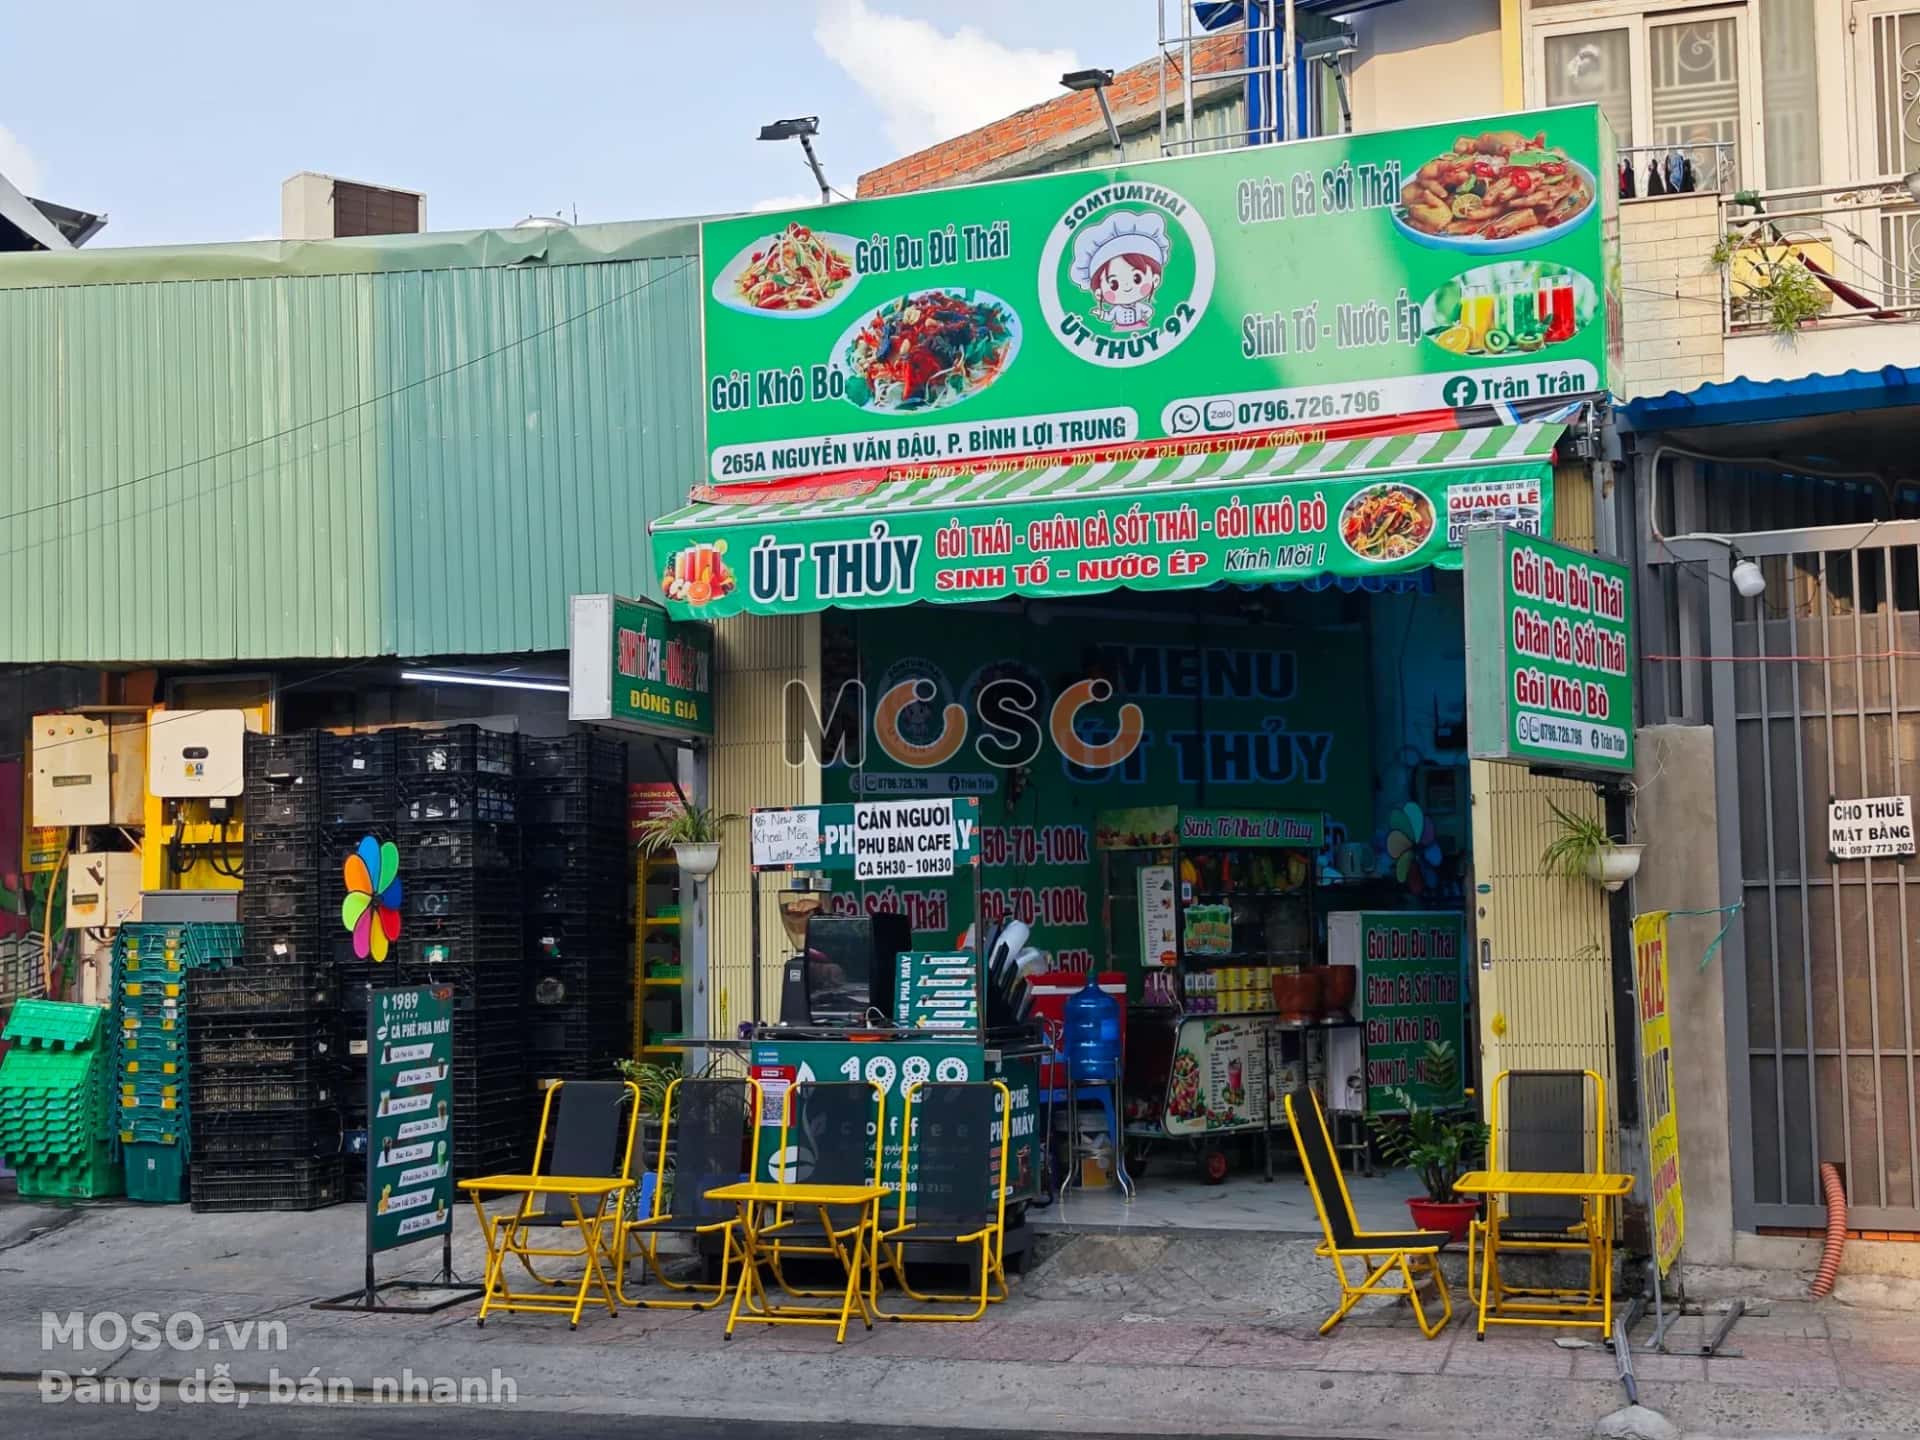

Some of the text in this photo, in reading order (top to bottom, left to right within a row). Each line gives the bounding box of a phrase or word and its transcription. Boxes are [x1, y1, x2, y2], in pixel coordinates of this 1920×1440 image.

[1064, 185, 1187, 230] SOMTUMTHAI
[1237, 161, 1401, 224] Chân Gà Sốt Thái
[855, 222, 1010, 275] Gỏi Đu Đủ Thái
[1061, 304, 1197, 360] ÚT THỦY 92
[1242, 314, 1287, 360] Sinh
[1292, 301, 1319, 354] Tố
[1336, 303, 1390, 348] Nước
[1395, 290, 1423, 343] Ép
[711, 363, 844, 412] Gỏi Khô Bò
[1210, 371, 1586, 425] Zalo 0796.726.796 Trân Trân
[721, 416, 1127, 476] 265A NGUYỄN VĂN ĐẬU, P. BÌNH LỢI TRUNG
[1450, 488, 1538, 509] QUANG LÊ
[936, 519, 966, 557] GỎI
[972, 519, 1012, 555] THÁI
[1029, 513, 1079, 550] CHÂN
[1084, 511, 1110, 547] GÀ
[1115, 504, 1151, 544] SỐT
[1154, 505, 1197, 541] THÁI
[1215, 496, 1248, 538] GỎI
[1255, 497, 1293, 534] KHÔ
[1299, 492, 1327, 531] BÒ
[752, 524, 920, 599] ÚT THỦY
[937, 567, 1006, 590] SINH
[1015, 557, 1048, 585] TỐ
[1079, 554, 1159, 582] NƯỚC
[1169, 546, 1208, 576] ÉP
[1225, 546, 1270, 571] Kính
[1277, 545, 1312, 567] Mời
[1513, 548, 1623, 619] Gỏi Đu Đủ Thái
[1514, 609, 1625, 673] Chân Gà Sốt Thái
[1098, 644, 1296, 700] MENU
[1516, 670, 1608, 718] Gỏi Khô Bò
[1167, 714, 1335, 785] THỦY
[1832, 820, 1911, 845] MẶT BẰNG
[1834, 797, 1905, 820] CHO THUÊ
[858, 837, 885, 858] PHỤ
[918, 833, 951, 852] CAFE
[858, 861, 874, 876] CA
[876, 859, 905, 875] 5H30
[916, 858, 951, 873] 10H30
[982, 827, 1088, 865] 50-70-100k
[1850, 844, 1872, 855] 0937
[1876, 843, 1893, 854] 773
[1896, 842, 1914, 852] 202
[903, 888, 949, 930] Thái
[391, 991, 419, 1011] 1989
